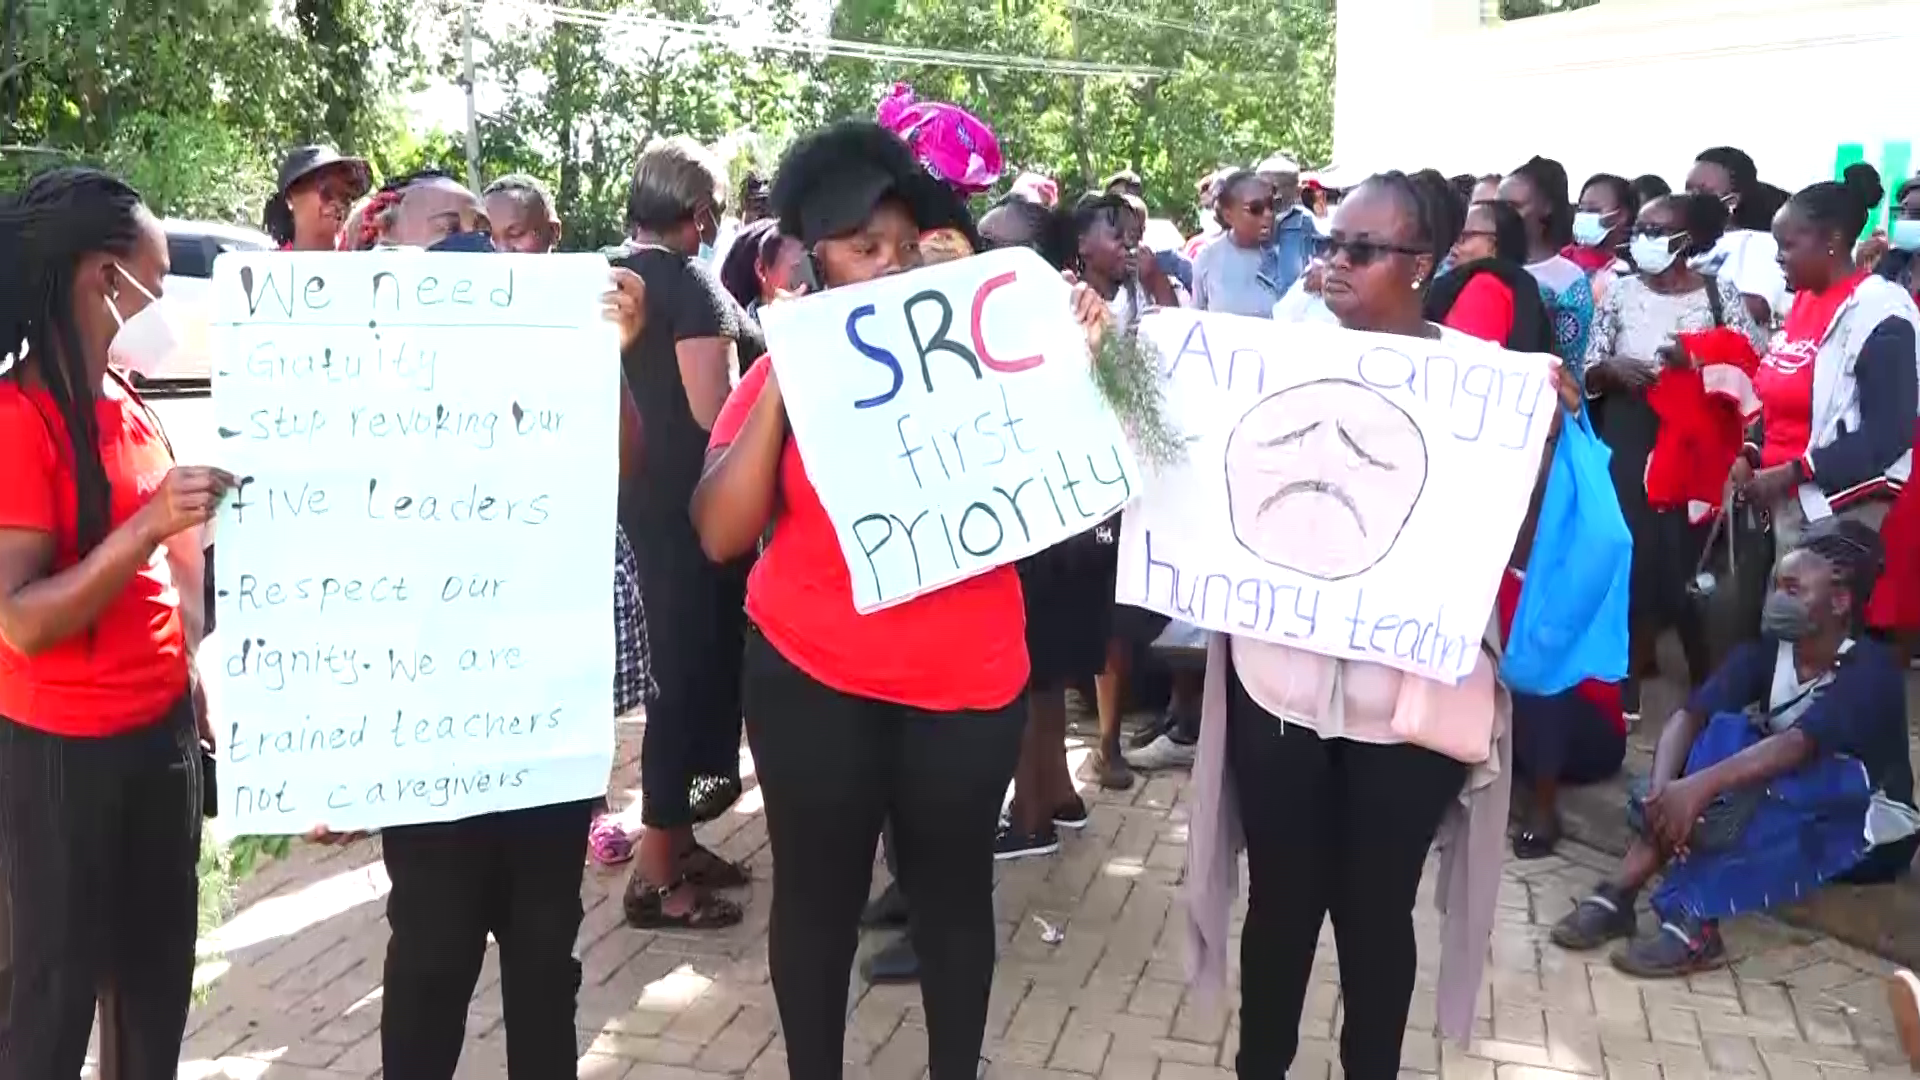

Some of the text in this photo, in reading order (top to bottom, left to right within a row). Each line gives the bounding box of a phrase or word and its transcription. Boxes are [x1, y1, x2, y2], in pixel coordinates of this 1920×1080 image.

[240, 263, 514, 318] We need
[845, 270, 1045, 410] SRC
[1165, 320, 1545, 450] An angry
[350, 404, 498, 449] revoking
[897, 384, 1037, 489] first
[1144, 529, 1320, 638] hungry
[389, 645, 437, 683] We
[458, 645, 527, 672] are
[229, 706, 564, 762] trained teachers
[235, 764, 531, 818] not caregivers
